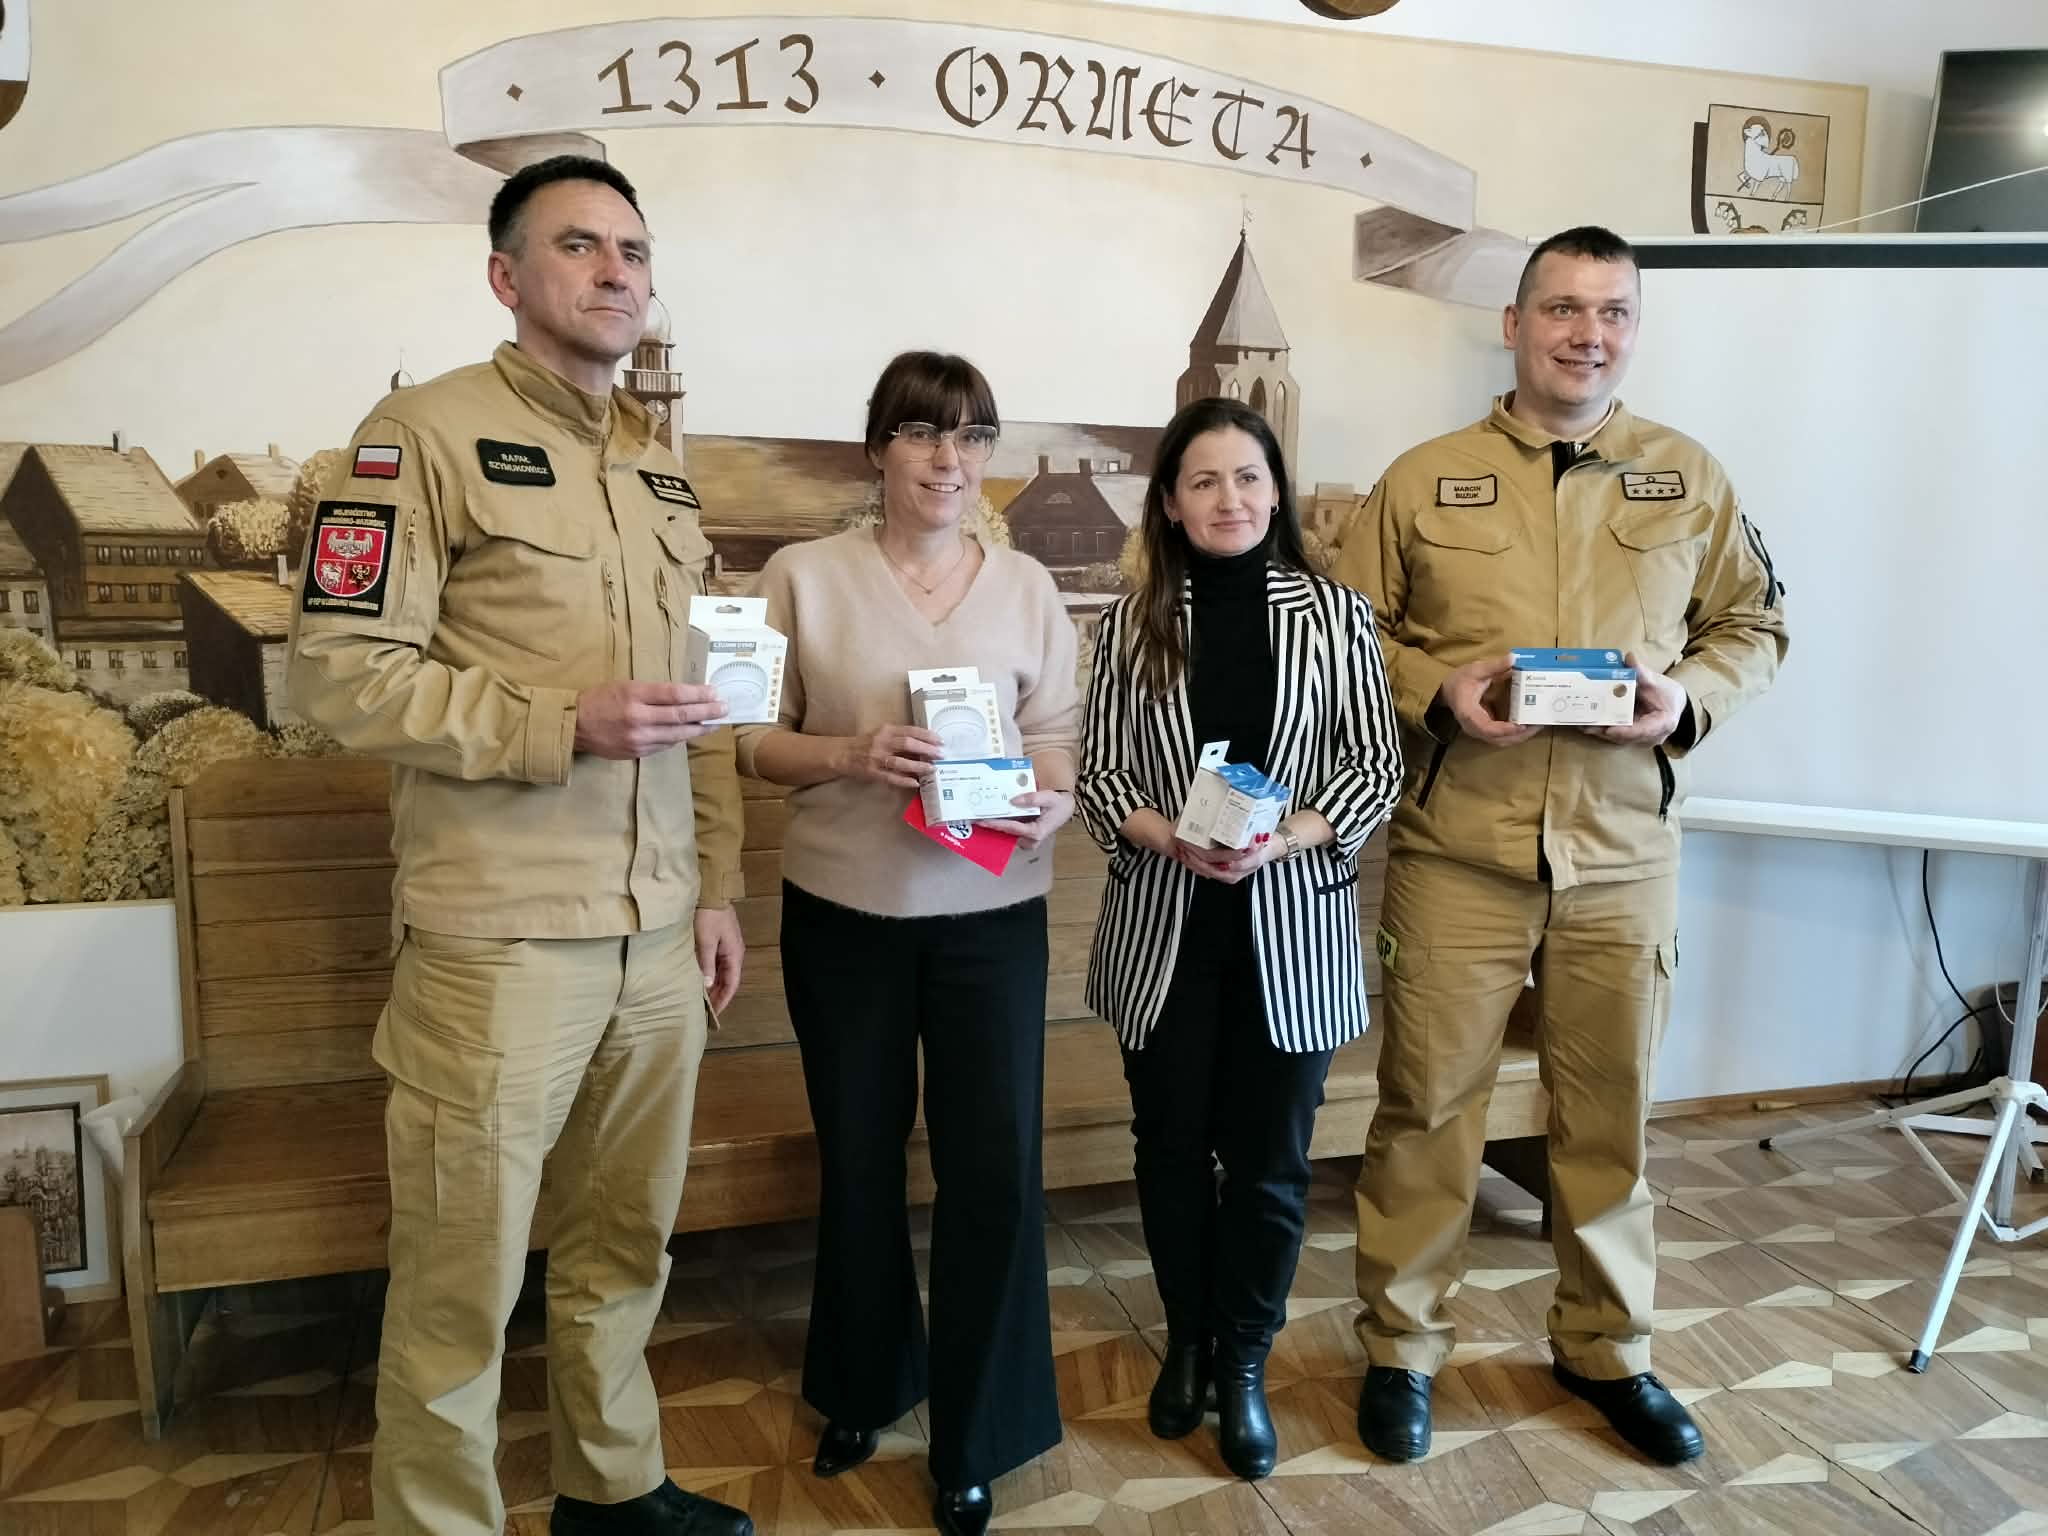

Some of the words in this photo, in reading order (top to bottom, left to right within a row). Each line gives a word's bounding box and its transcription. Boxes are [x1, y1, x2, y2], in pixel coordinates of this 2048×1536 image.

[598, 33, 820, 116] 1313
[935, 45, 1317, 170] ORNETA
[500, 453, 531, 464] RAFAŁ
